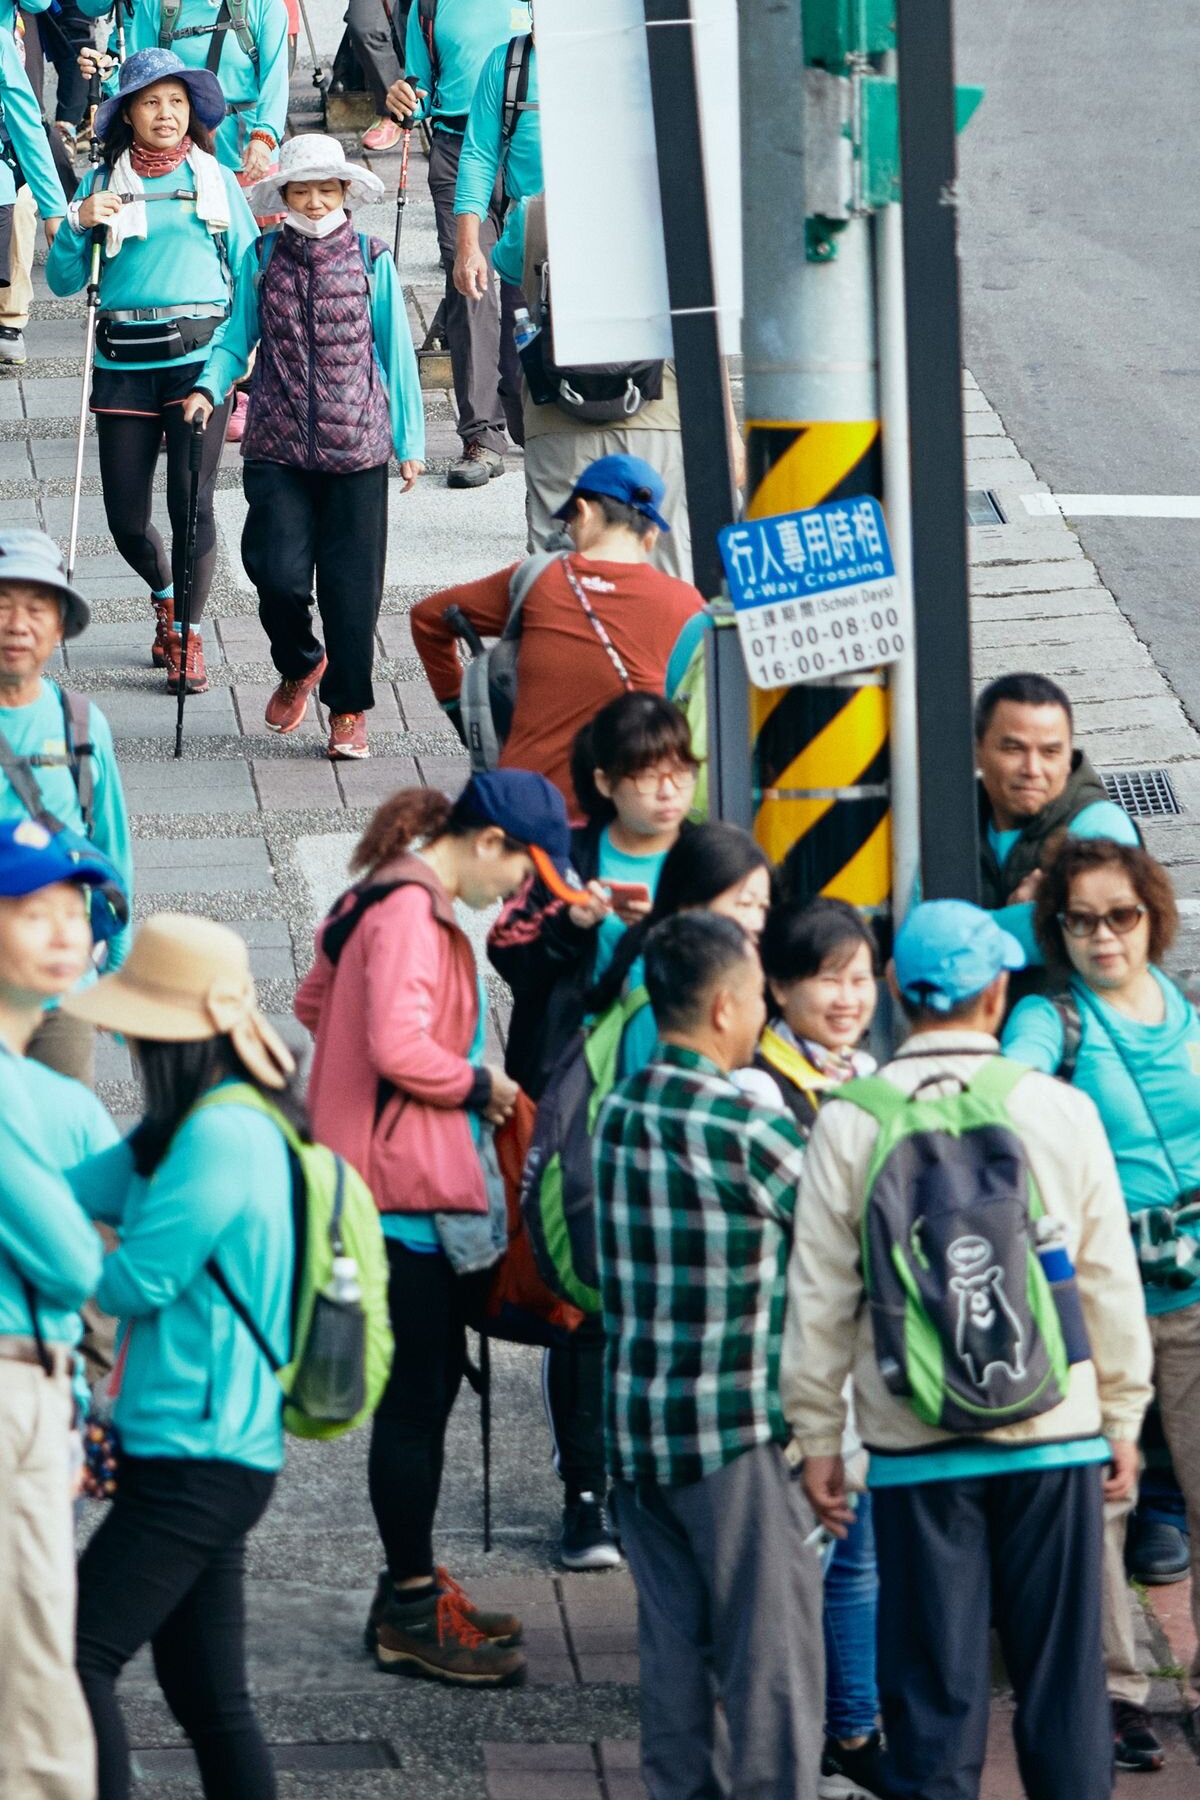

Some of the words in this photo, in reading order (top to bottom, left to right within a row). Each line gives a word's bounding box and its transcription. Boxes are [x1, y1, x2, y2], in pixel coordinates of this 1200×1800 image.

[727, 502, 883, 586] 行人專用時相
[743, 580, 798, 600] 4-Way
[804, 560, 885, 588] Crossing
[861, 584, 894, 604] Days)
[751, 607, 898, 657] 07:00-08:00
[759, 634, 905, 683] 16:00-18:00
